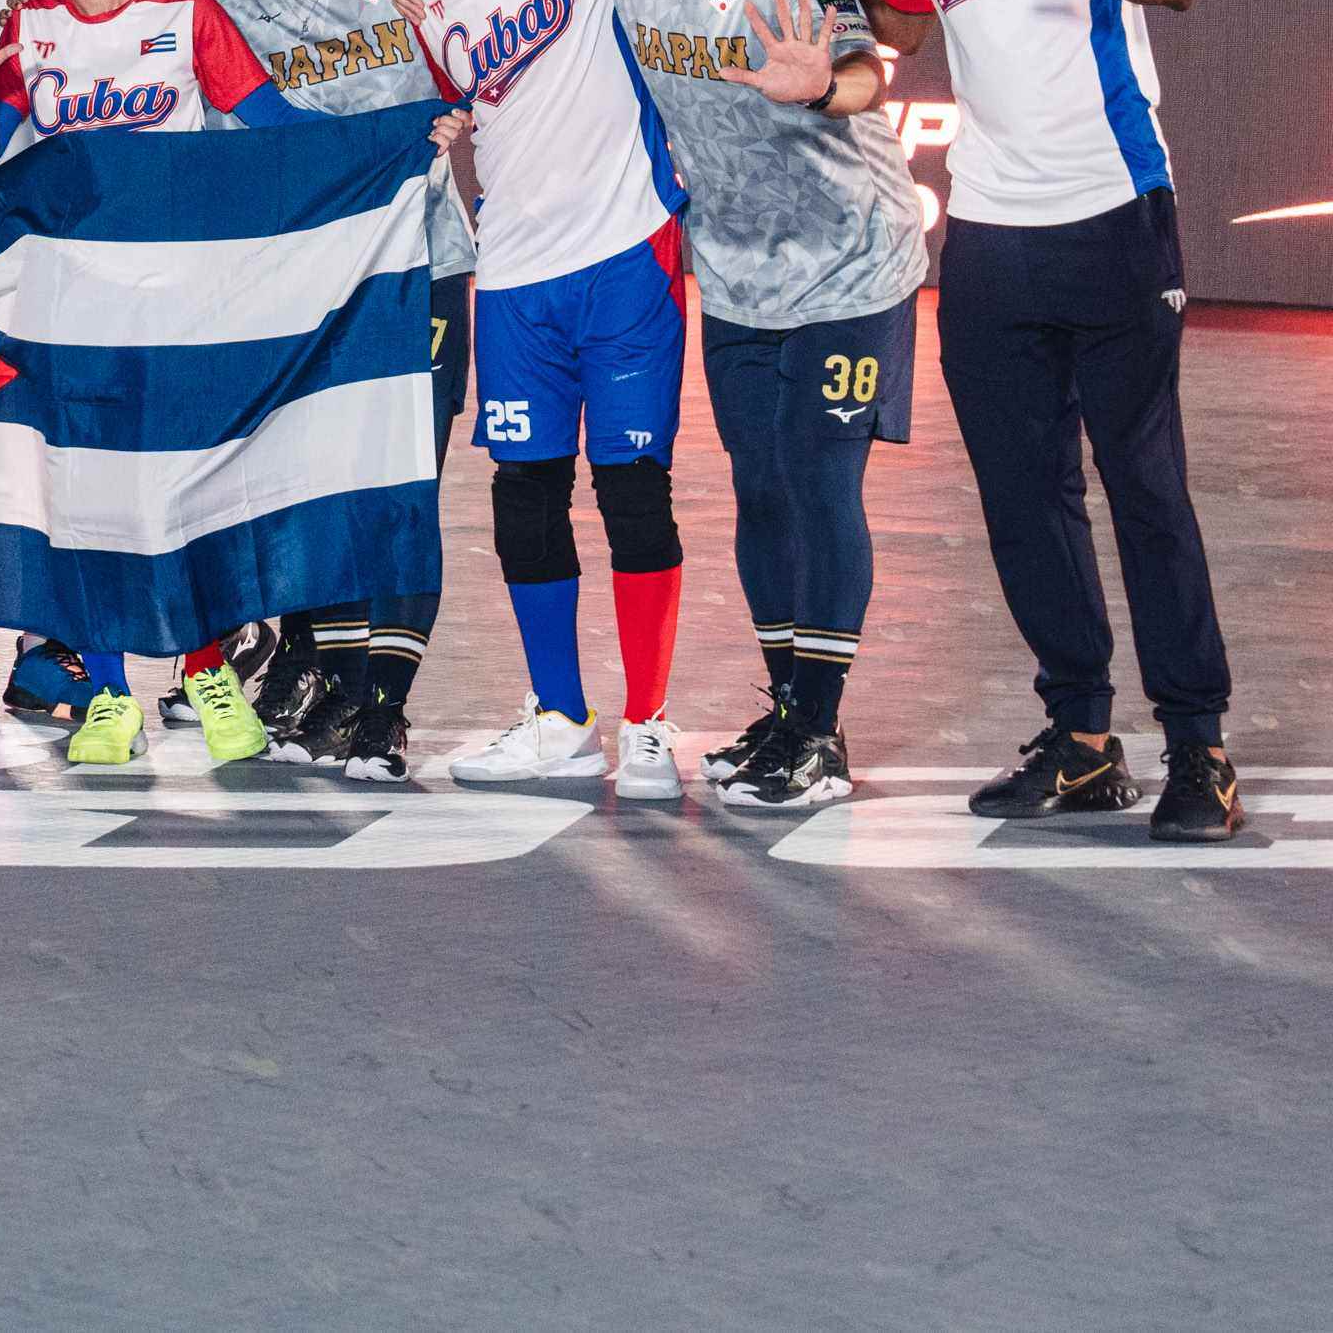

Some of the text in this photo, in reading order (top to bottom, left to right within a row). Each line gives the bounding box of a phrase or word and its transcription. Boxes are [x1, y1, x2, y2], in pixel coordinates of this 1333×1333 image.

[267, 18, 412, 94] JAPAN
[28, 68, 180, 136] Cuba
[821, 354, 879, 402] 38
[485, 400, 532, 442] 25
